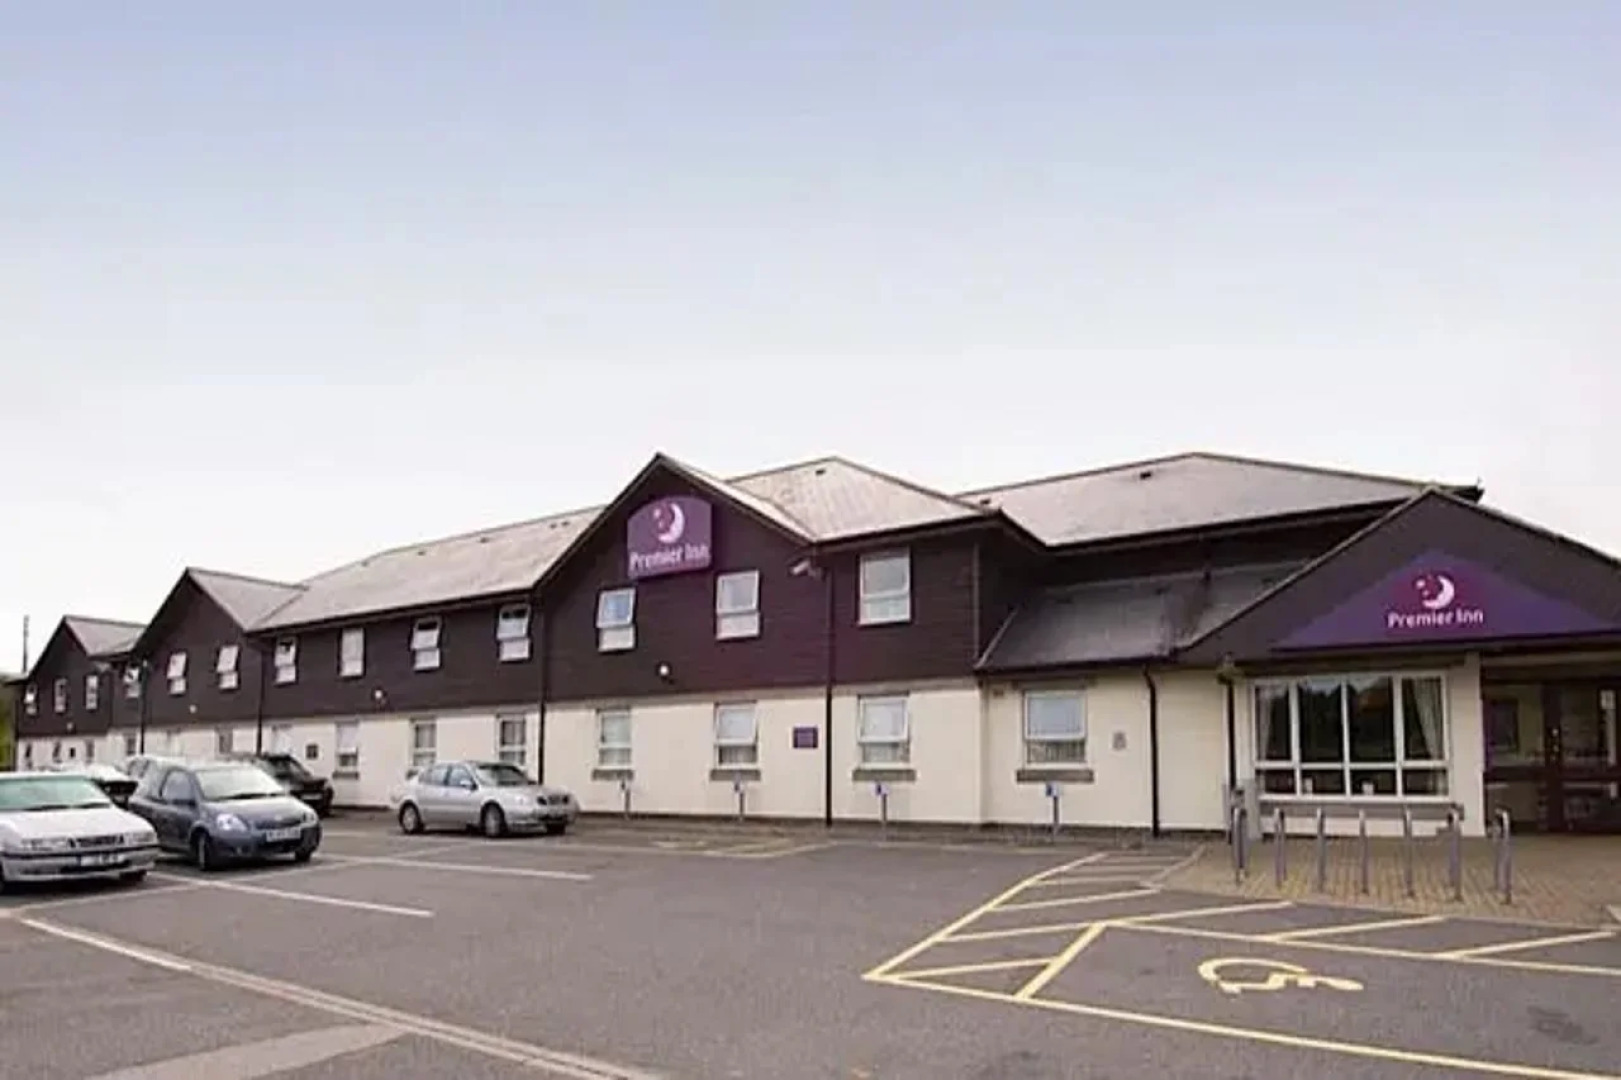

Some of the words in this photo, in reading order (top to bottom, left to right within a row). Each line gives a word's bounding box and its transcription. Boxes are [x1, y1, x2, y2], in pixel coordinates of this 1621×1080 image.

[629, 547, 683, 571] Premier
[685, 543, 710, 562] Inn
[1388, 610, 1453, 628] Premier
[1455, 607, 1484, 624] Inn
